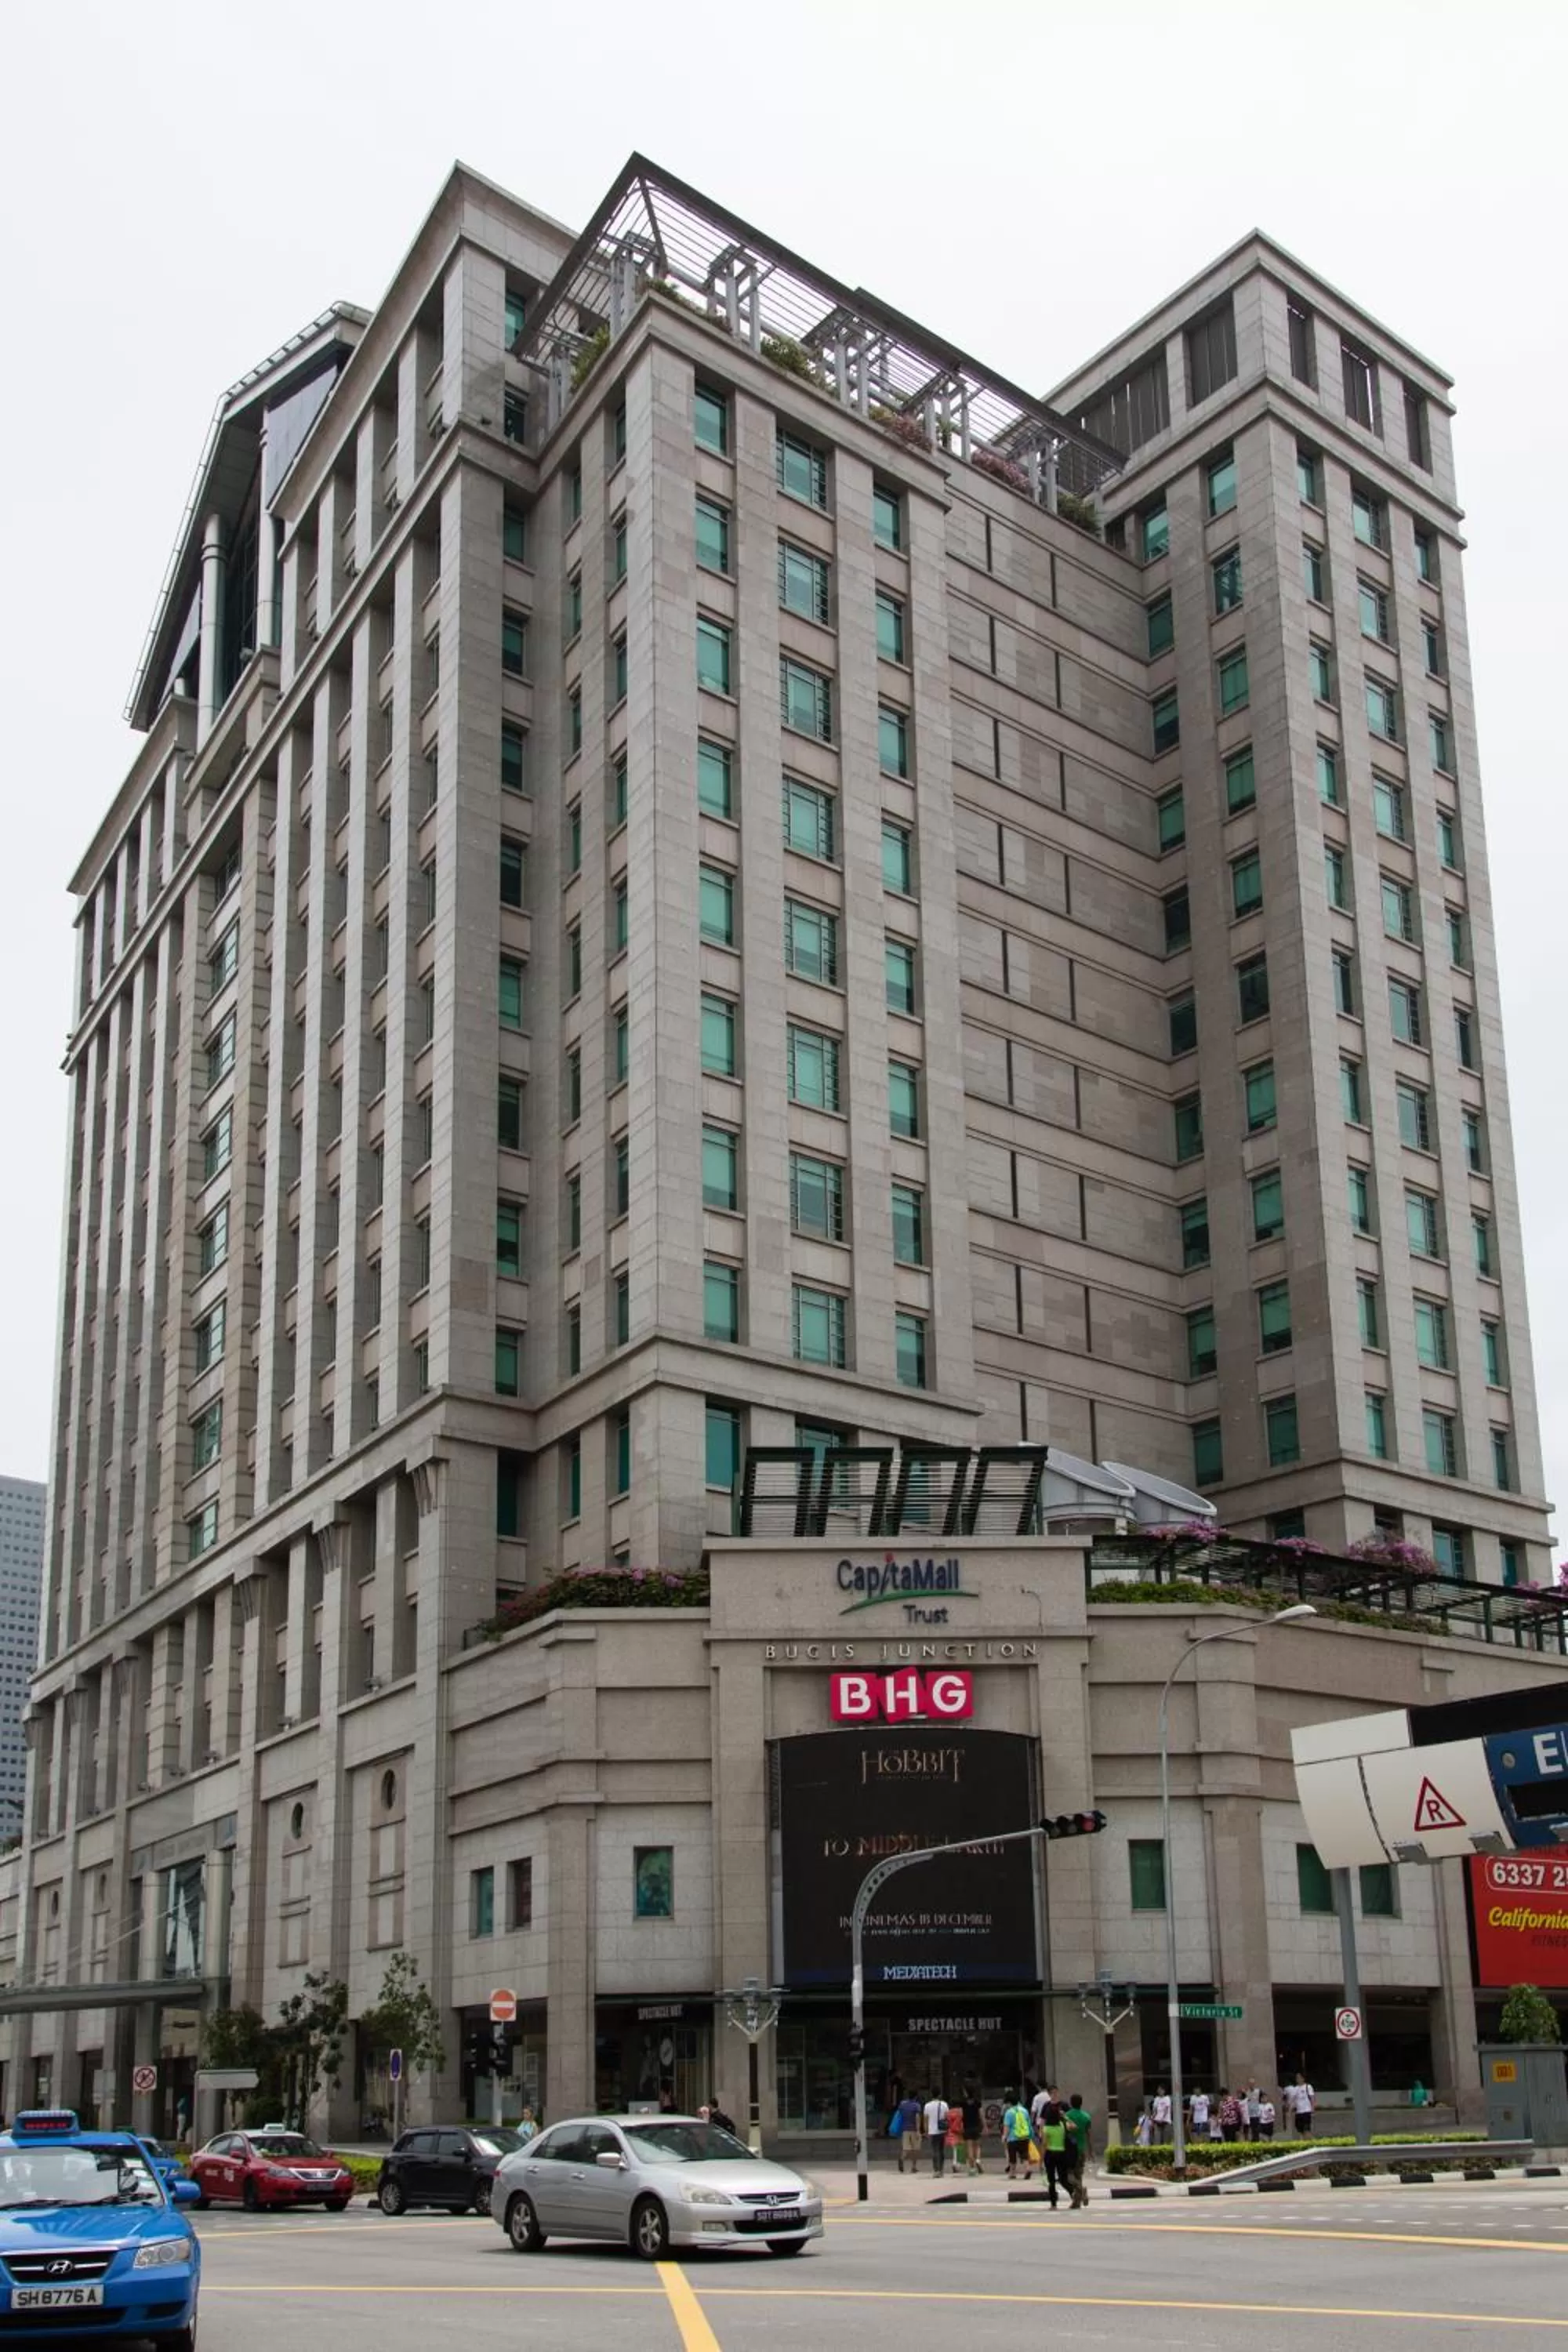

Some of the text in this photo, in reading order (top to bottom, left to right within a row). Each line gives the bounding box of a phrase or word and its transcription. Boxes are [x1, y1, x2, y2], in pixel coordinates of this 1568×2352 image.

[837, 1552, 959, 1599] CapitaMall
[902, 1604, 949, 1623] Trust
[765, 1643, 1036, 1659] BUGIS JUNCTION
[840, 1675, 967, 1714] BHG
[862, 1749, 965, 1784] HOBBIT
[1426, 1799, 1446, 1822] R
[1493, 1862, 1568, 1887] 6337 2
[908, 2016, 1003, 2031] SPECTACLE HUT
